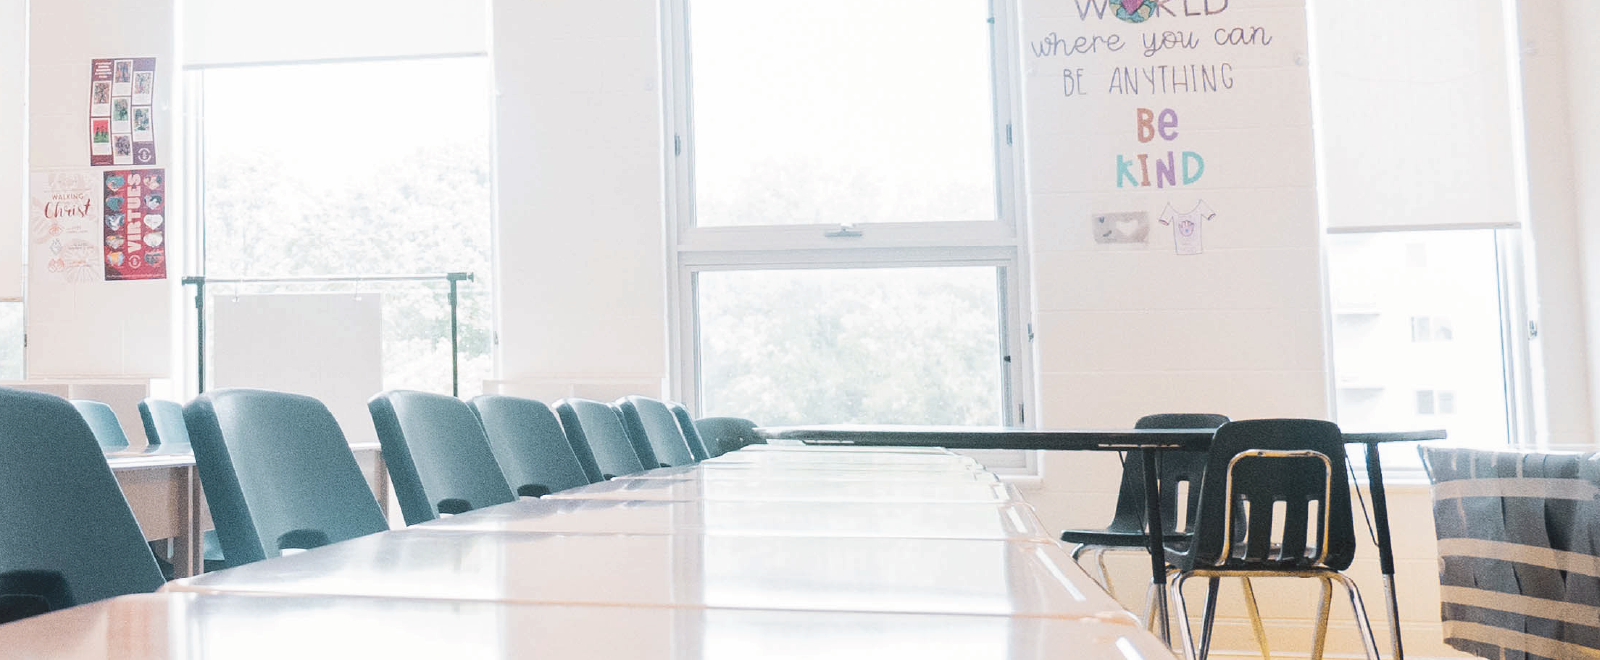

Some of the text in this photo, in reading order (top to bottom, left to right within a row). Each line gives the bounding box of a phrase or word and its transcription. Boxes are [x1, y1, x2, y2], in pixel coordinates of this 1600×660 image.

[1031, 26, 1273, 58] where you can
[1063, 62, 1234, 97] BE ANYTHING
[1116, 151, 1205, 189] KIND
[44, 198, 91, 219] Christ
[52, 193, 84, 201] WALKING
[127, 173, 142, 254] VIRTUES
